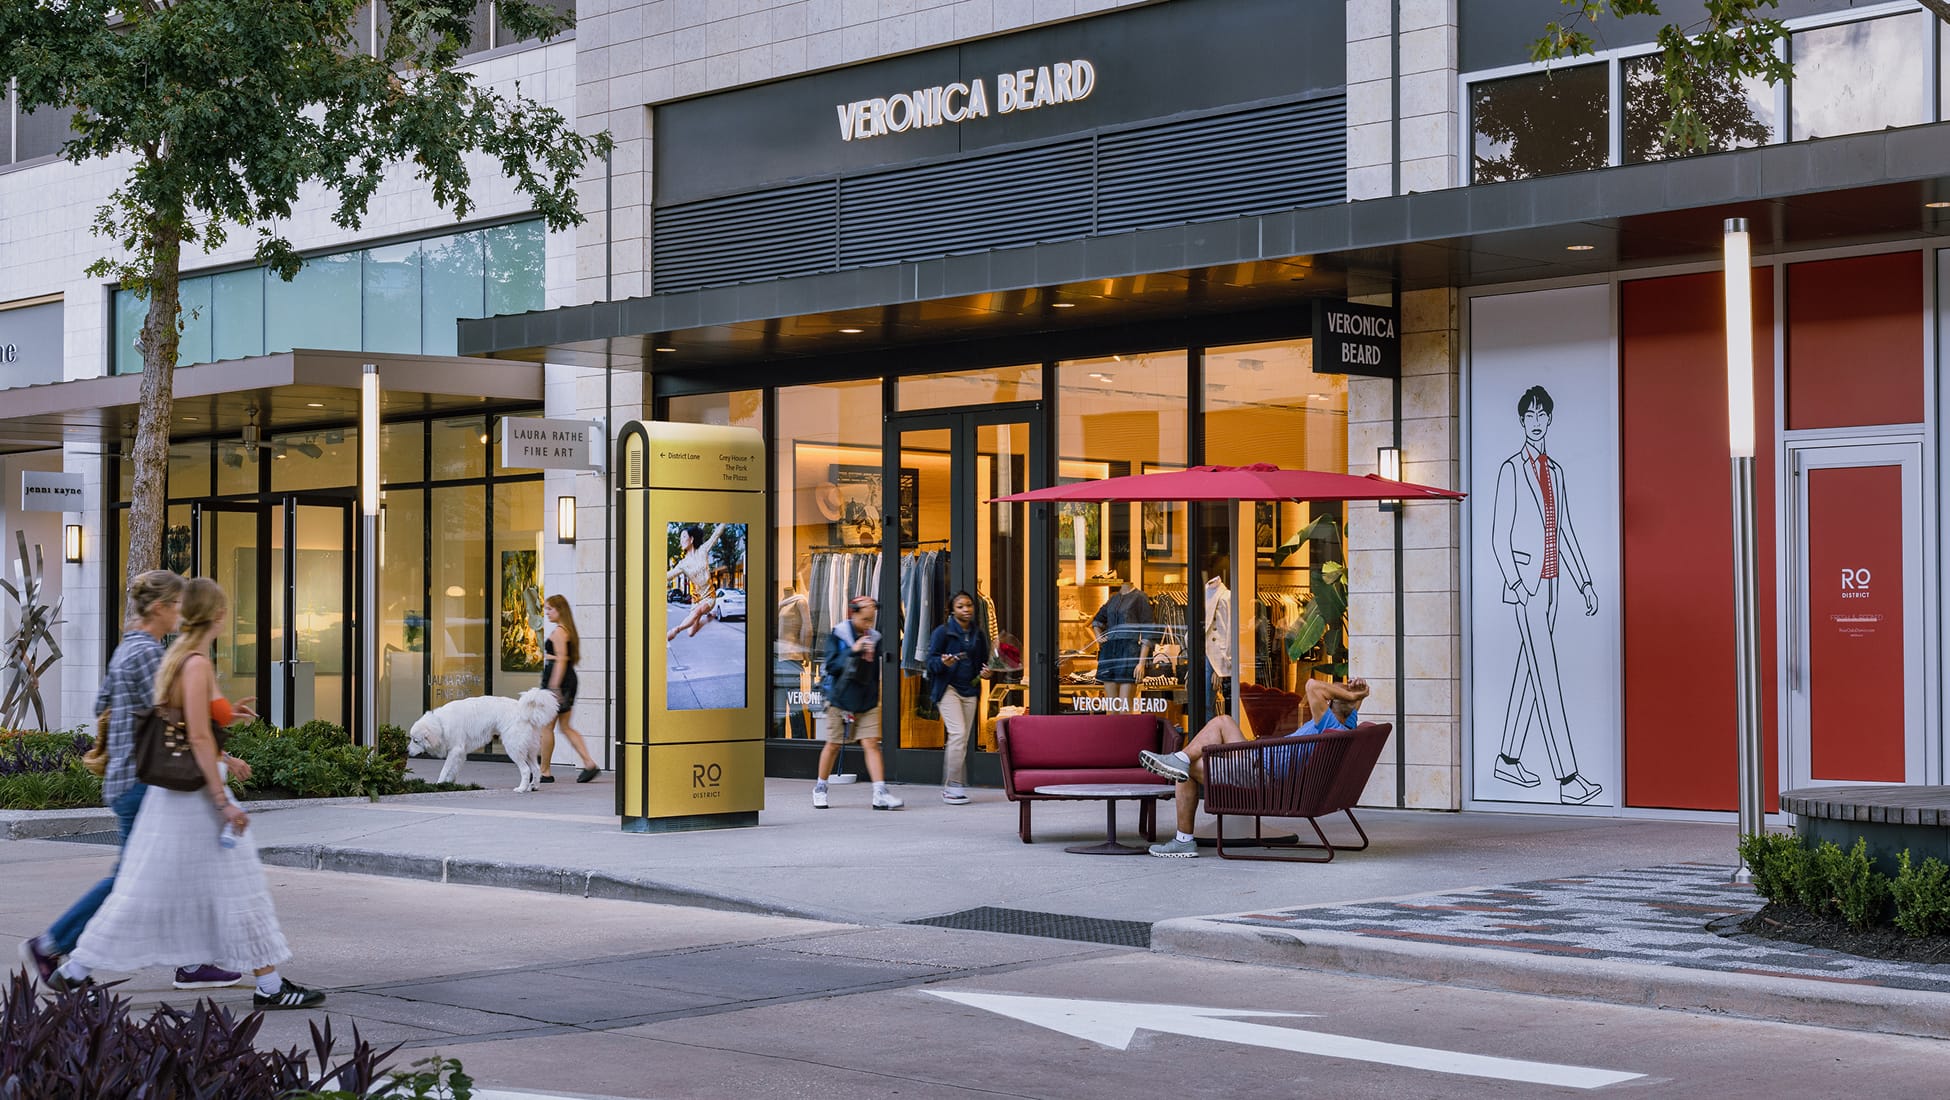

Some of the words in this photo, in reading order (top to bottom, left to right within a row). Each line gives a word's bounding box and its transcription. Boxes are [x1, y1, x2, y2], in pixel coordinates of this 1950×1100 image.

[836, 78, 989, 142] VERONICA
[997, 59, 1096, 114] BEARD
[1327, 312, 1395, 339] VERONICA
[1341, 342, 1381, 365] BEARD
[514, 429, 547, 440] LAURA
[552, 431, 584, 442] RATHE
[524, 446, 548, 457] FINE
[554, 448, 574, 457] ART
[668, 451, 686, 460] District
[687, 452, 700, 460] Lane
[726, 464, 735, 472] The
[723, 473, 732, 481] The
[25, 486, 51, 495] jenni
[1841, 568, 1871, 589] RO
[787, 691, 823, 705] VERONI
[1072, 696, 1130, 712] VERONICA
[1133, 697, 1168, 713] BEARD
[693, 763, 722, 788] RO
[692, 791, 721, 799] DISTRICT
